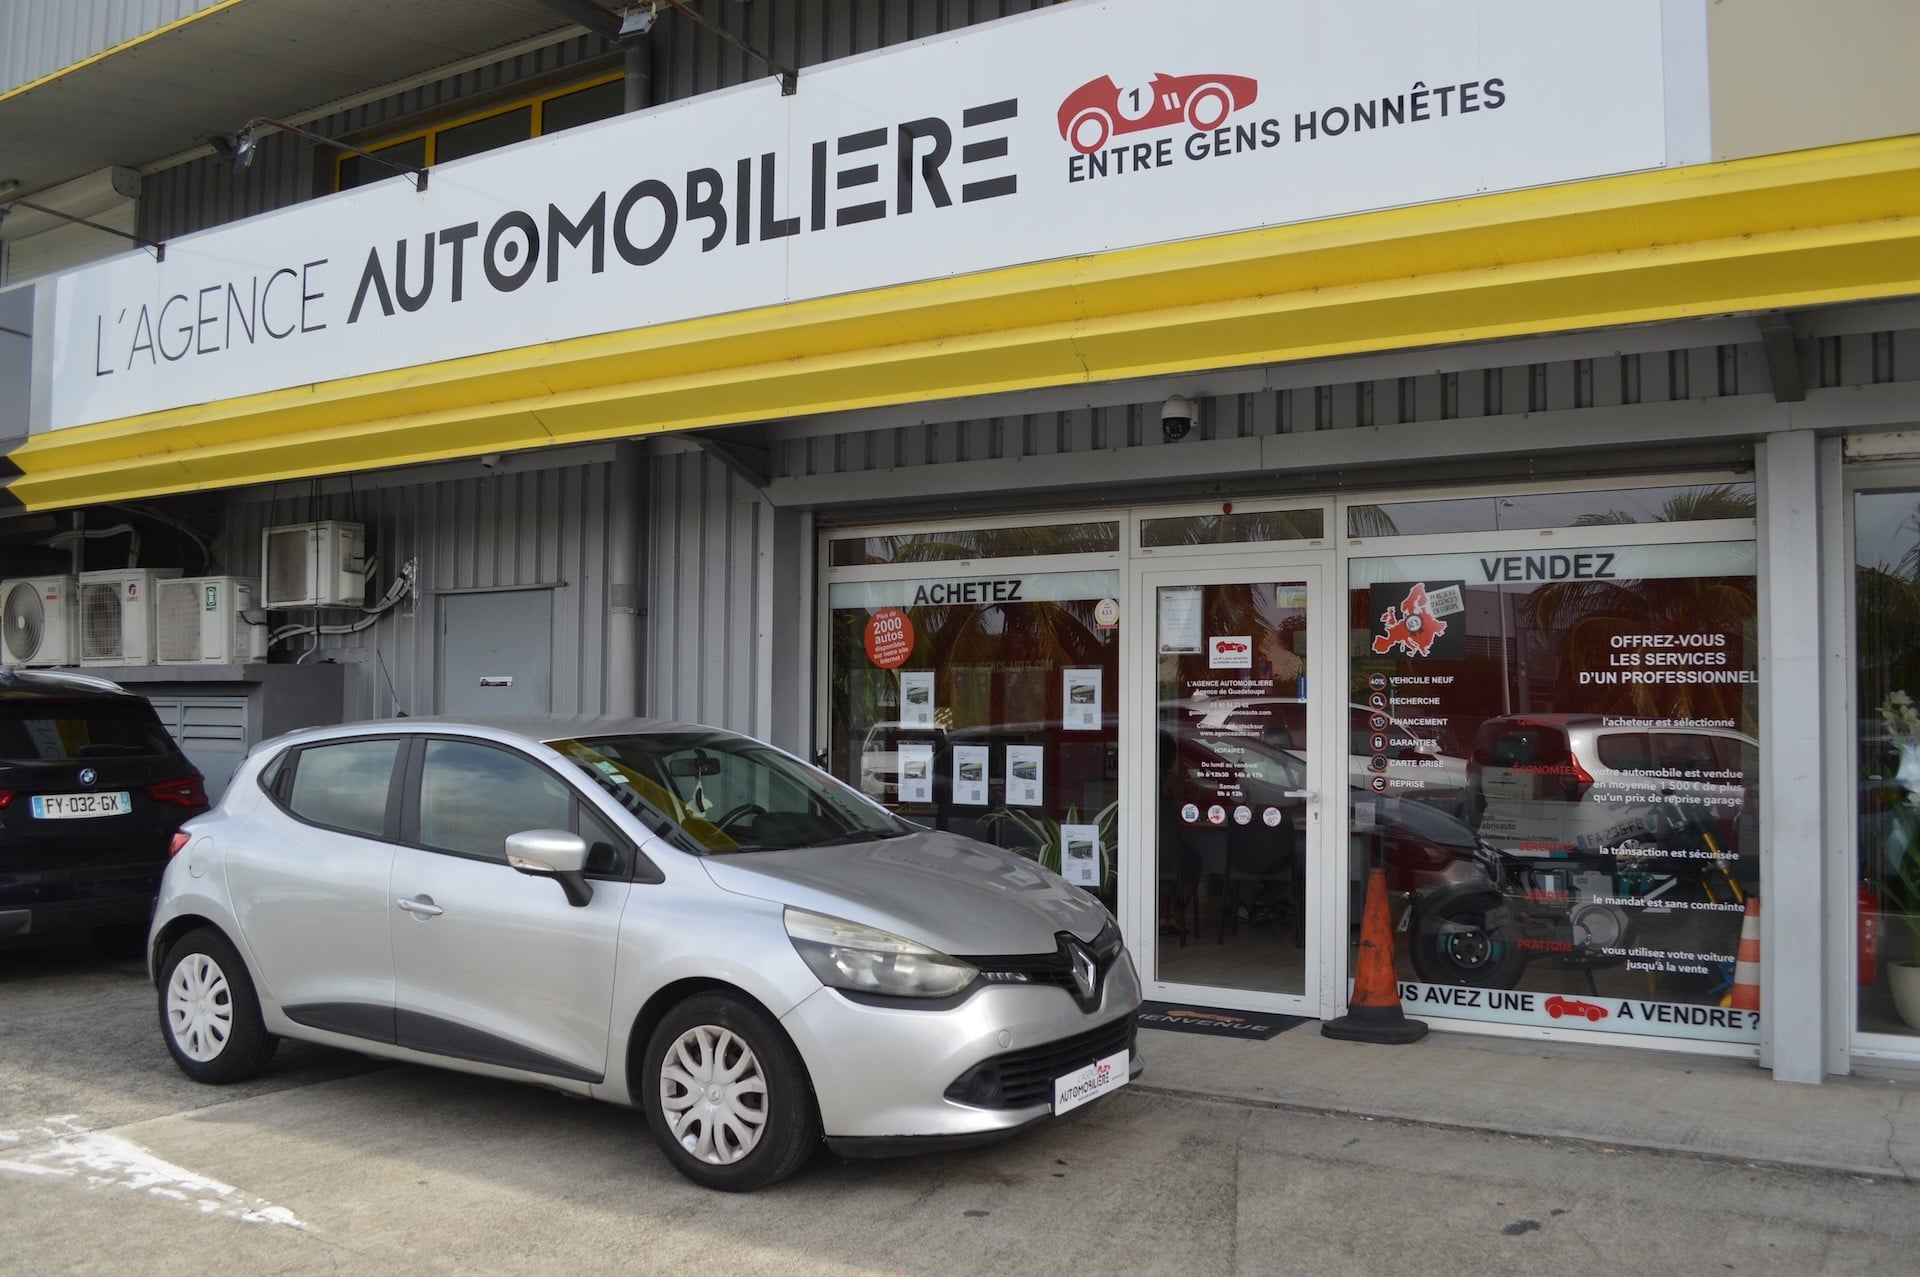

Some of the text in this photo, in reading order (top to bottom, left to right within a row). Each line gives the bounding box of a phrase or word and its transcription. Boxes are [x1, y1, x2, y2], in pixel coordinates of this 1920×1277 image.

[1069, 78, 1506, 183] ENTRE GENS HONNÊTES
[95, 98, 1018, 378] L'AGENCE AUTOMOBILIERE
[1480, 553, 1616, 582] VENDEZ
[914, 580, 1022, 605] ACHETEZ
[873, 617, 902, 635] 2000
[875, 631, 904, 645] autos
[1610, 634, 1725, 648] OFFREZ-VOUS
[1610, 652, 1726, 666] LES SERVICES
[1389, 676, 1430, 684] VEHICULE
[1432, 676, 1454, 684] NEUF
[1580, 670, 1759, 684] D'UN PROFESSIONNEL
[1195, 688, 1218, 696] Agence
[1228, 688, 1265, 696] Guadeloupe
[1389, 697, 1441, 705] RECHERCHE
[1389, 718, 1448, 726] FINANCEMENT
[1602, 717, 1735, 727] l'acheteur est sélectionné
[1390, 739, 1437, 747] GARANTIES
[1419, 760, 1444, 768] GRISE
[1594, 768, 1744, 779] votre automobile est vendue
[1390, 780, 1425, 788] REPRISE
[1608, 782, 1657, 791] moyenne
[1692, 782, 1701, 790] €
[1702, 782, 1715, 791] de
[1719, 782, 1743, 793] plus
[1593, 793, 1743, 807] qu'un prix de reprise garage
[1599, 845, 1609, 855] la
[1610, 846, 1668, 858] transaction
[1670, 849, 1687, 859] est
[1689, 849, 1739, 860] sécurisée
[1593, 894, 1745, 913] le mandat est sans contrainte
[1516, 938, 1573, 952] PRATIQUE
[1601, 947, 1735, 963] vous utilisez votre voiture
[1626, 960, 1708, 974] jusqu'à la vente
[1399, 984, 1418, 1001] US
[1424, 987, 1481, 1008] AVEZ
[1488, 992, 1534, 1012] UNE
[1617, 1001, 1633, 1020] A
[1640, 1002, 1743, 1029] VENDRE
[1137, 1013, 1271, 1032] IENVENUE
